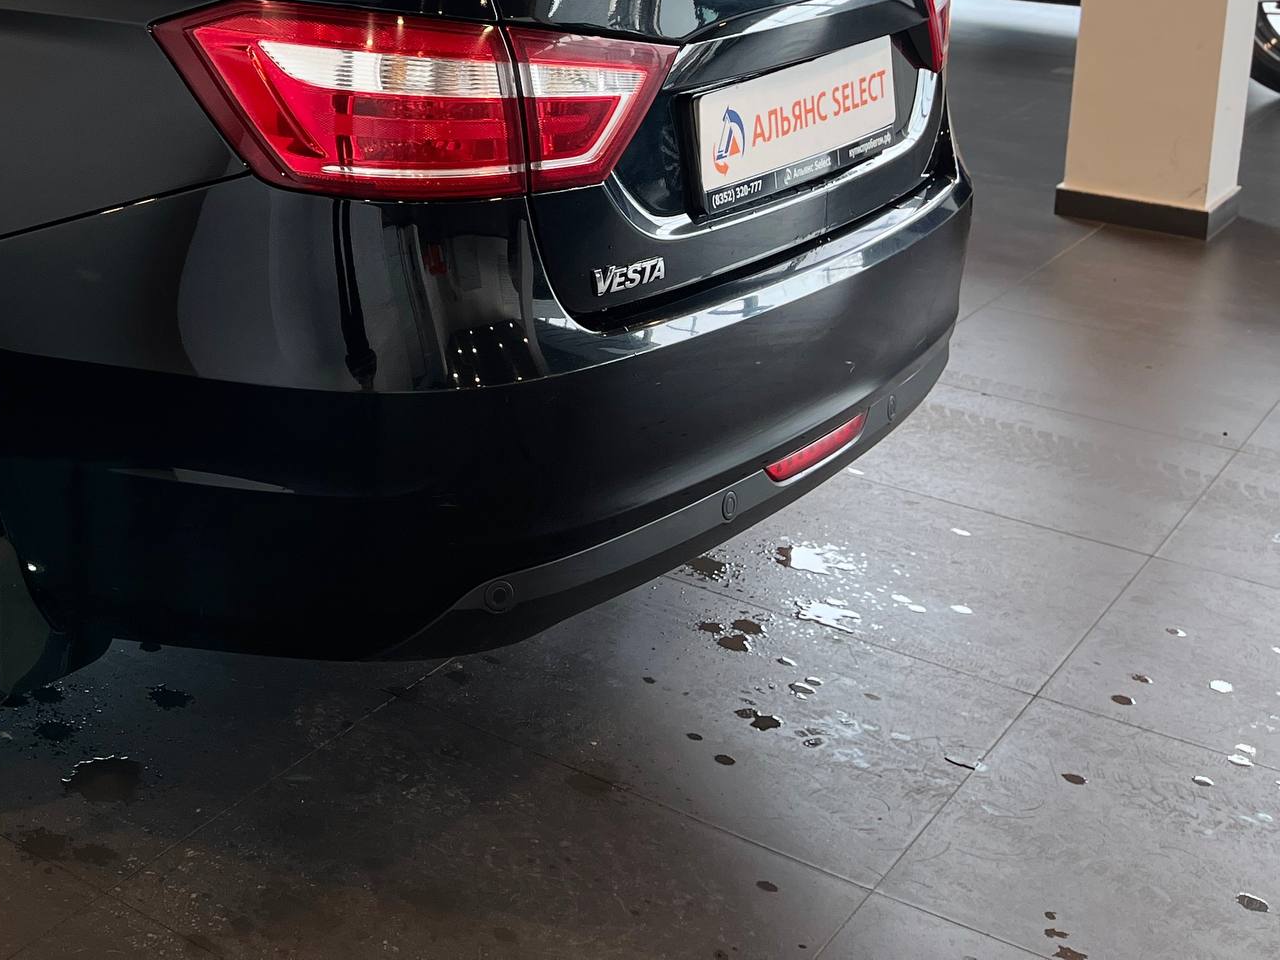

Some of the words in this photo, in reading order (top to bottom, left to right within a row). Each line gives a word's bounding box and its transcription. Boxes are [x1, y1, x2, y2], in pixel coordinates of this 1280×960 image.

[752, 91, 827, 147] АЛЬЯНС
[832, 70, 886, 117] SELECT
[712, 187, 735, 208] (8352)
[736, 179, 762, 199] 320-777
[592, 256, 665, 296] VESTA
